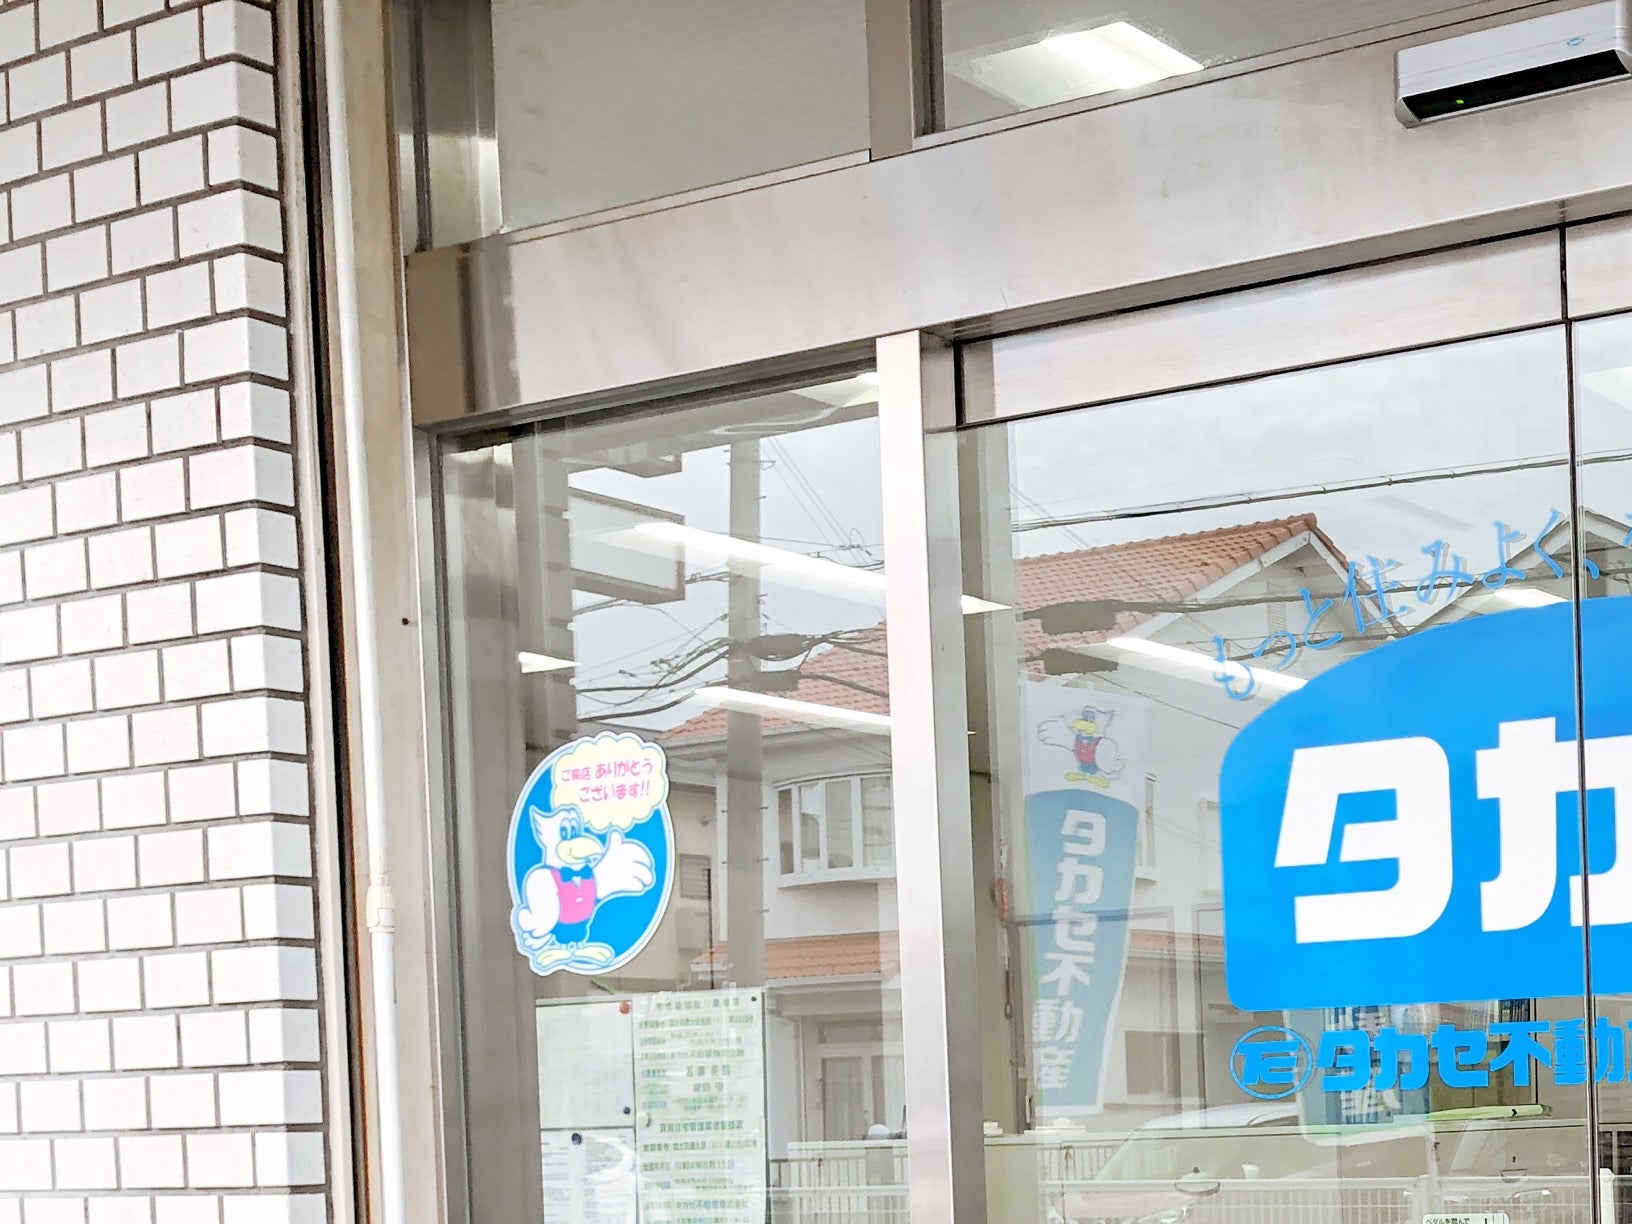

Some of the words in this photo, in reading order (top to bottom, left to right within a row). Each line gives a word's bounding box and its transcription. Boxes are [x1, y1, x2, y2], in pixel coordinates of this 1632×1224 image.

[1032, 809, 1106, 1089] タカセ不動産
